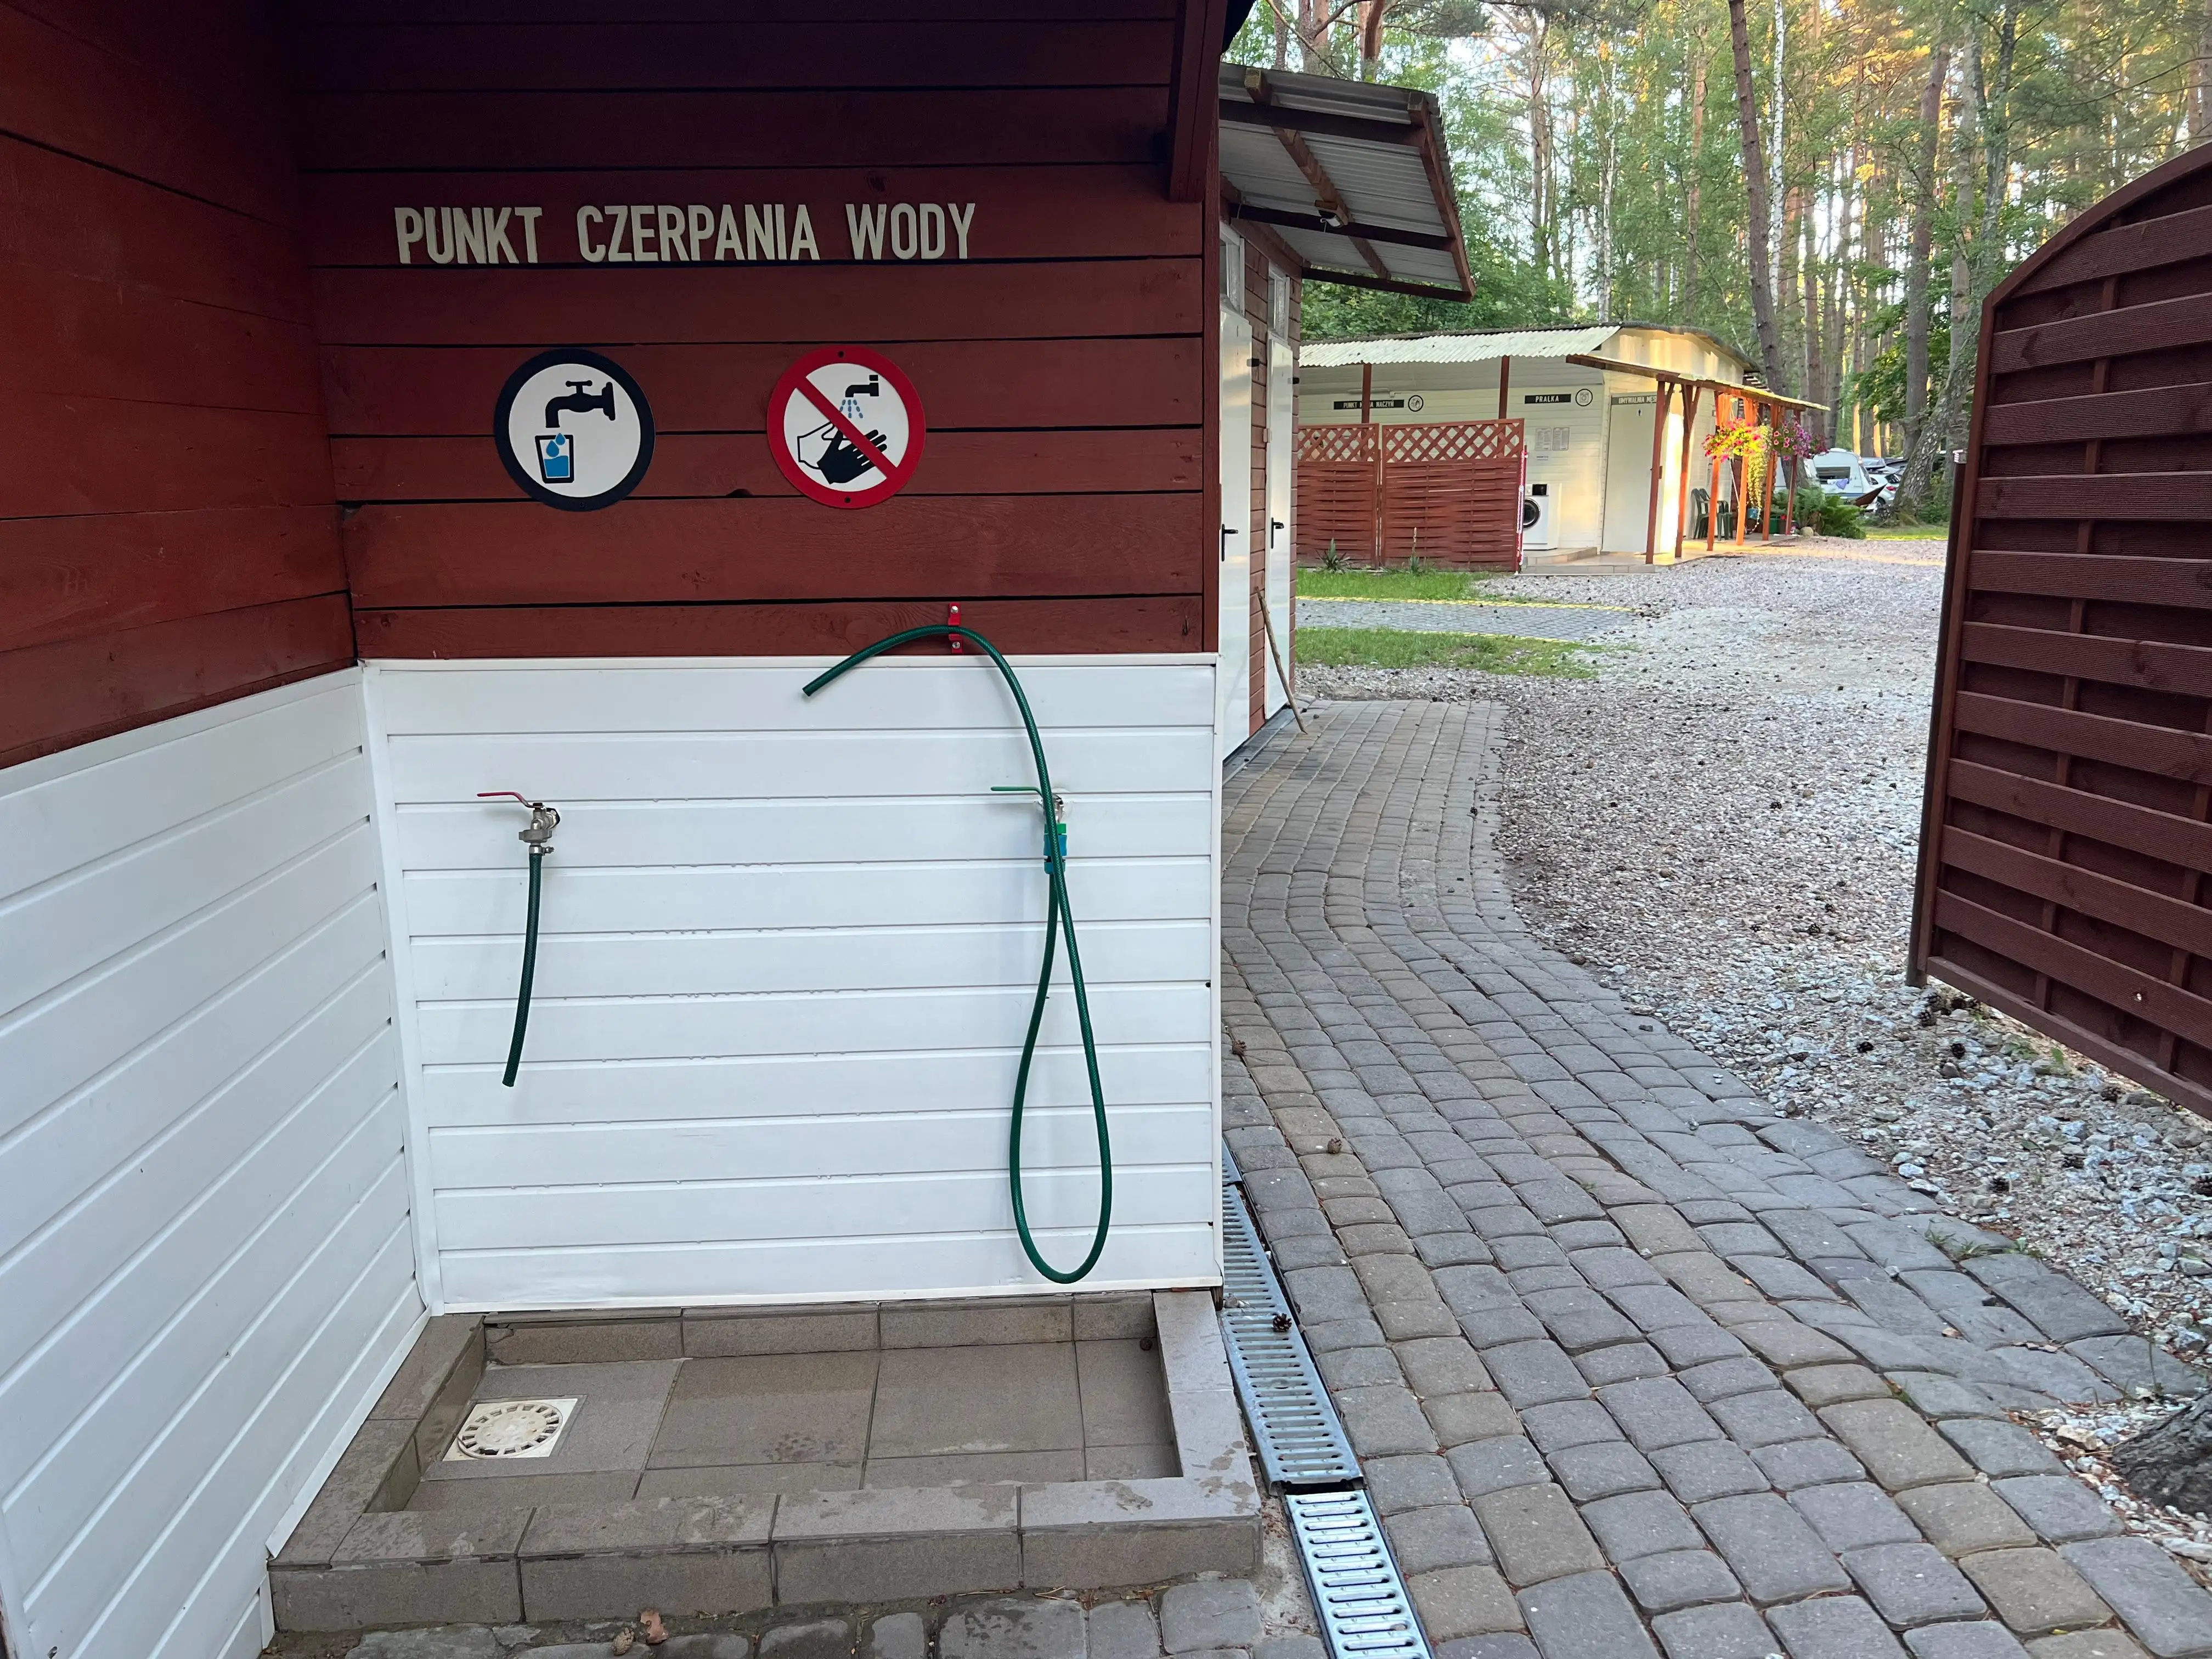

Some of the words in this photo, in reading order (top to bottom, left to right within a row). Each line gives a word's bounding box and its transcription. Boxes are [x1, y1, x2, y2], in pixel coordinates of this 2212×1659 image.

[394, 207, 543, 264] PUNKT
[577, 204, 821, 262] CZERPANIA
[845, 202, 976, 260] WODY
[1646, 395, 1657, 404] MĘS
